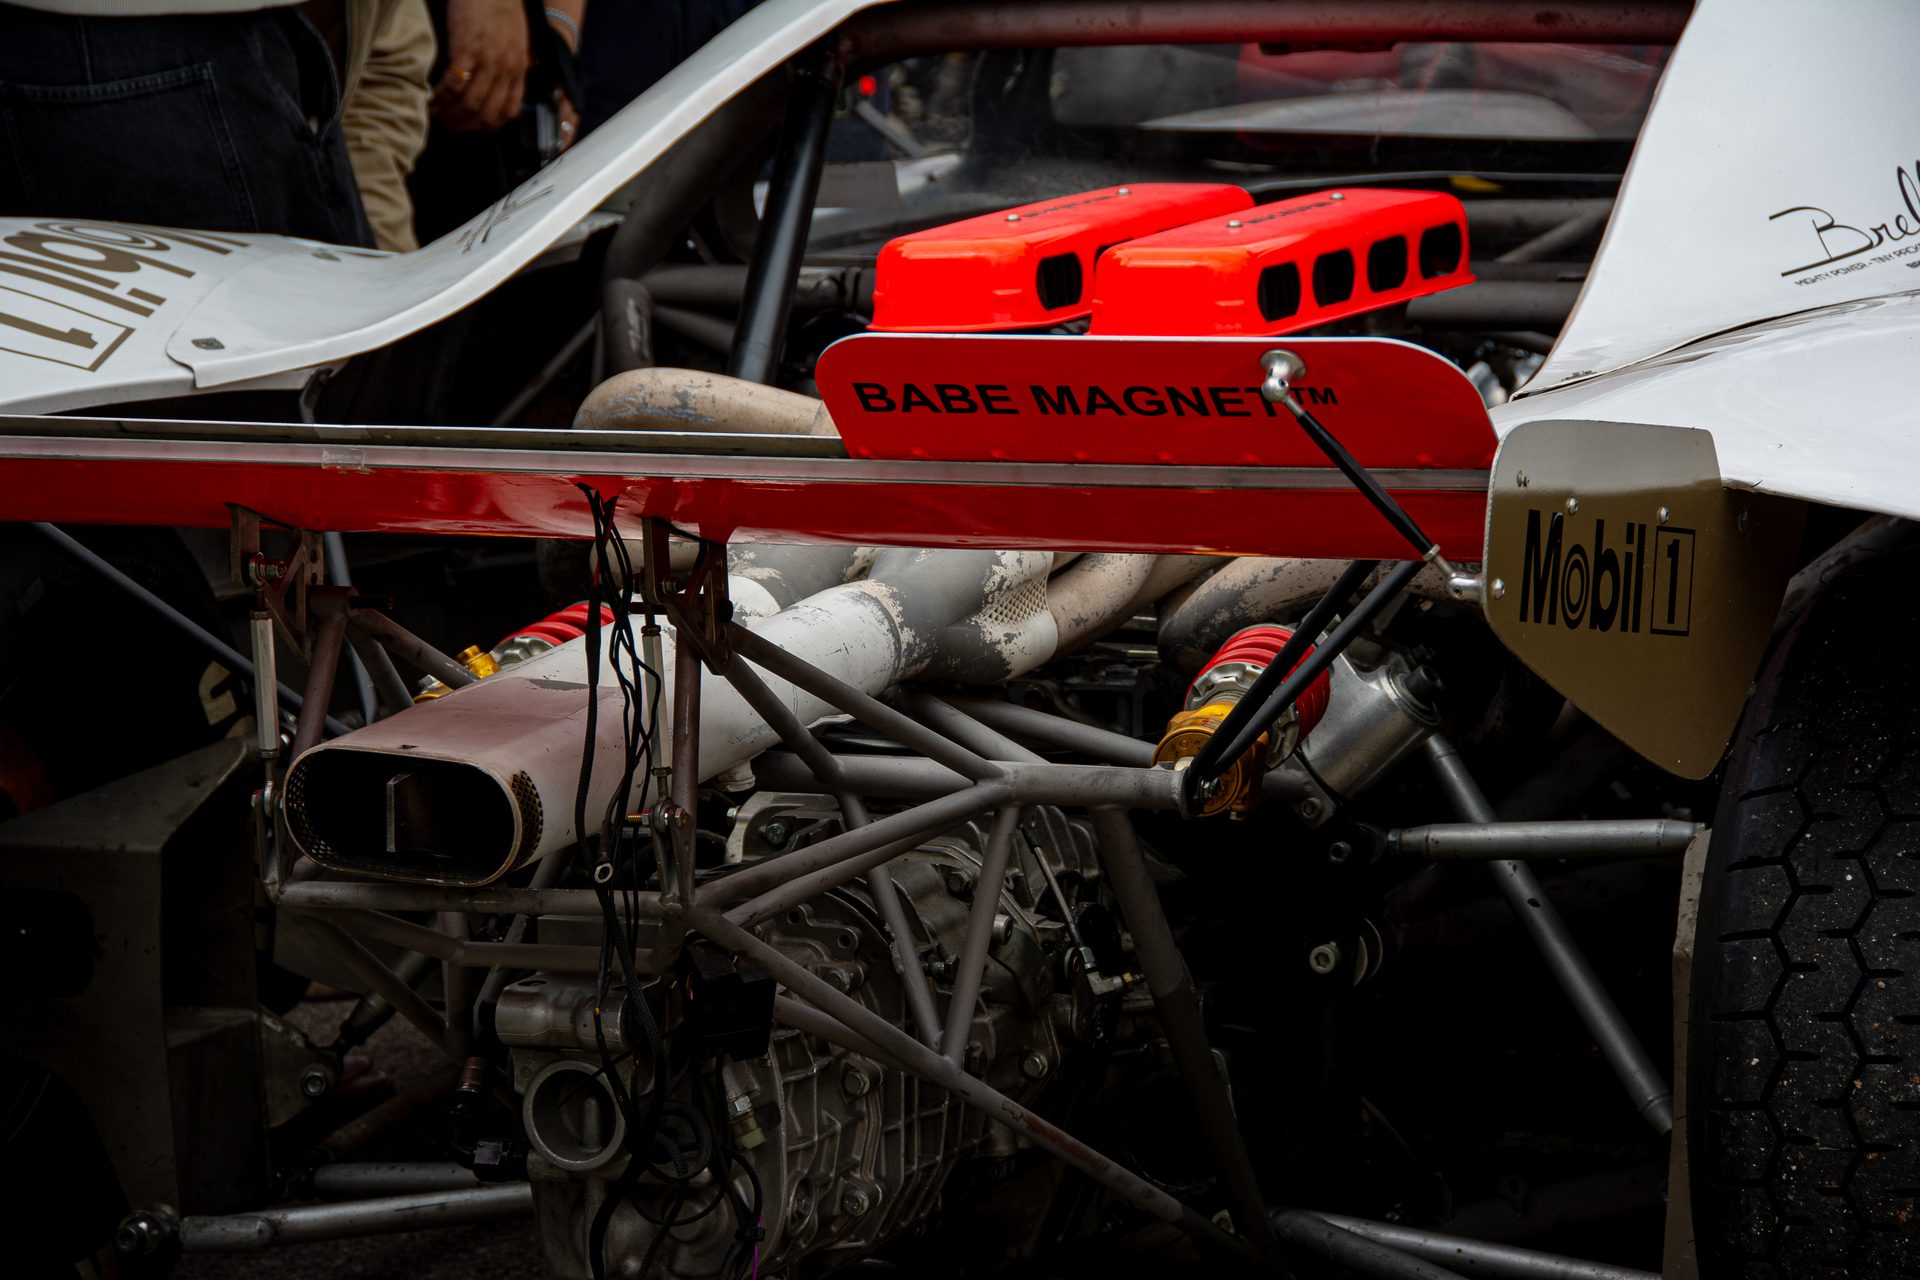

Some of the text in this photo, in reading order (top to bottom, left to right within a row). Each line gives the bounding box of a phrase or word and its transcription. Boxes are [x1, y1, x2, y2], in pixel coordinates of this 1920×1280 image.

[1794, 273, 1831, 286] MIGHTY
[1829, 262, 1868, 277] POWER
[1870, 253, 1896, 265] TINY
[853, 382, 1019, 415] BABE
[1519, 509, 1647, 634] Mobil
